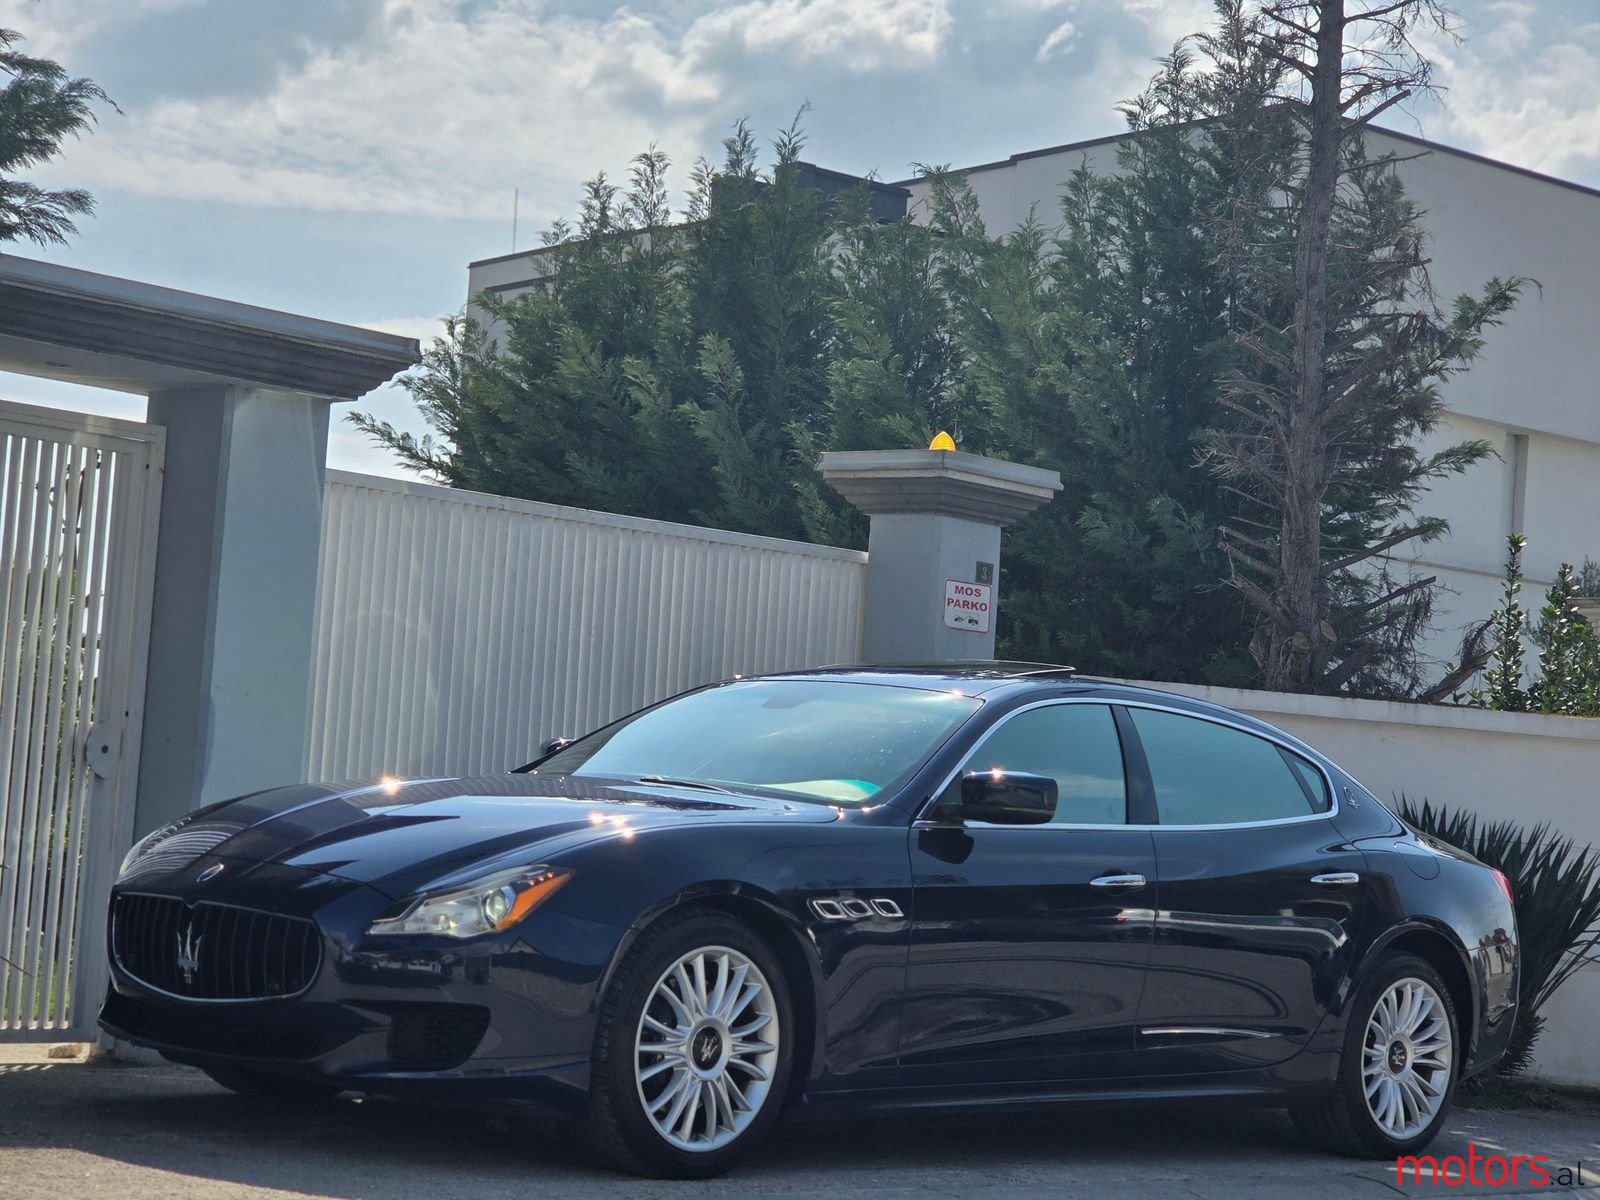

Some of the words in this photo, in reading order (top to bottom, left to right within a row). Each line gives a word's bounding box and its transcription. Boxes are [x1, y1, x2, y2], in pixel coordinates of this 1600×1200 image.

[981, 566, 988, 580] 3
[954, 585, 982, 597] MOS
[947, 598, 988, 612] PARKO
